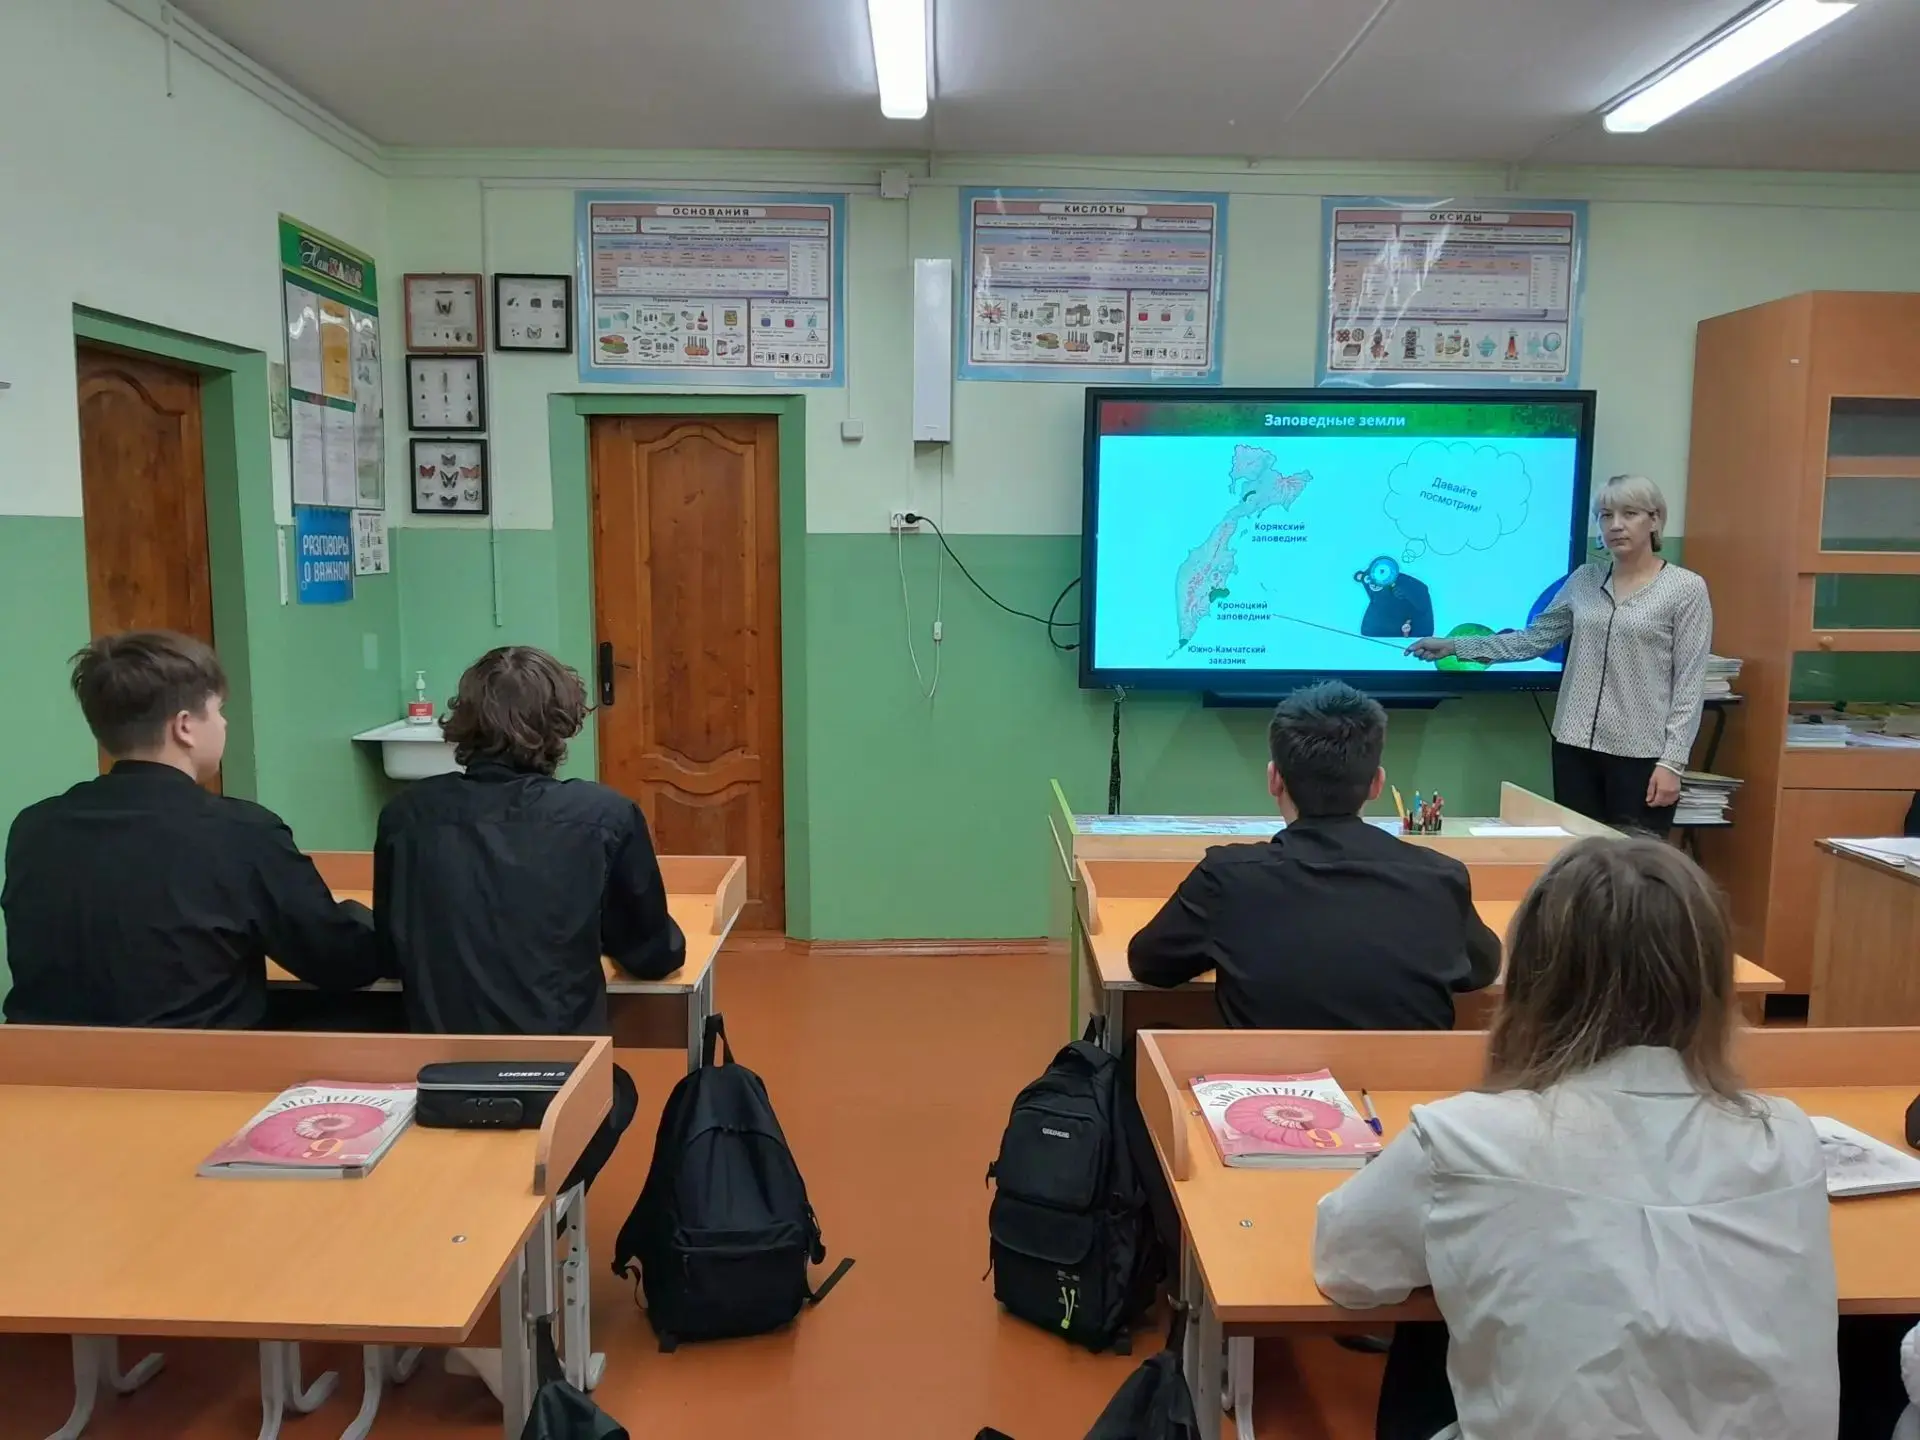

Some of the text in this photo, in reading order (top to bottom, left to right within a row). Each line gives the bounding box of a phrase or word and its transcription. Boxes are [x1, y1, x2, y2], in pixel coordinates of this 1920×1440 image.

[673, 207, 749, 216] ОСНОВАНИЯ
[1064, 205, 1126, 214] КИСЛОТЫ
[1429, 213, 1482, 222] ОКСИДЫ
[1264, 414, 1406, 428] Заповедные земли
[1432, 476, 1478, 498] Давайте
[1419, 490, 1482, 513] посмотрим!
[1254, 521, 1305, 532] Корякский
[303, 534, 350, 556] РАЗГОВОРЫ
[1251, 535, 1308, 543] заповедник
[304, 561, 350, 582] О ВАЖНОМ
[1217, 600, 1268, 611] Кроноцкий
[1216, 613, 1272, 621] заповедник
[1187, 644, 1266, 654] Южно-Камчатский
[1208, 1086, 1314, 1107] БИОЛОГИЯ
[1307, 1128, 1343, 1149] 9
[302, 1138, 343, 1159] 9
